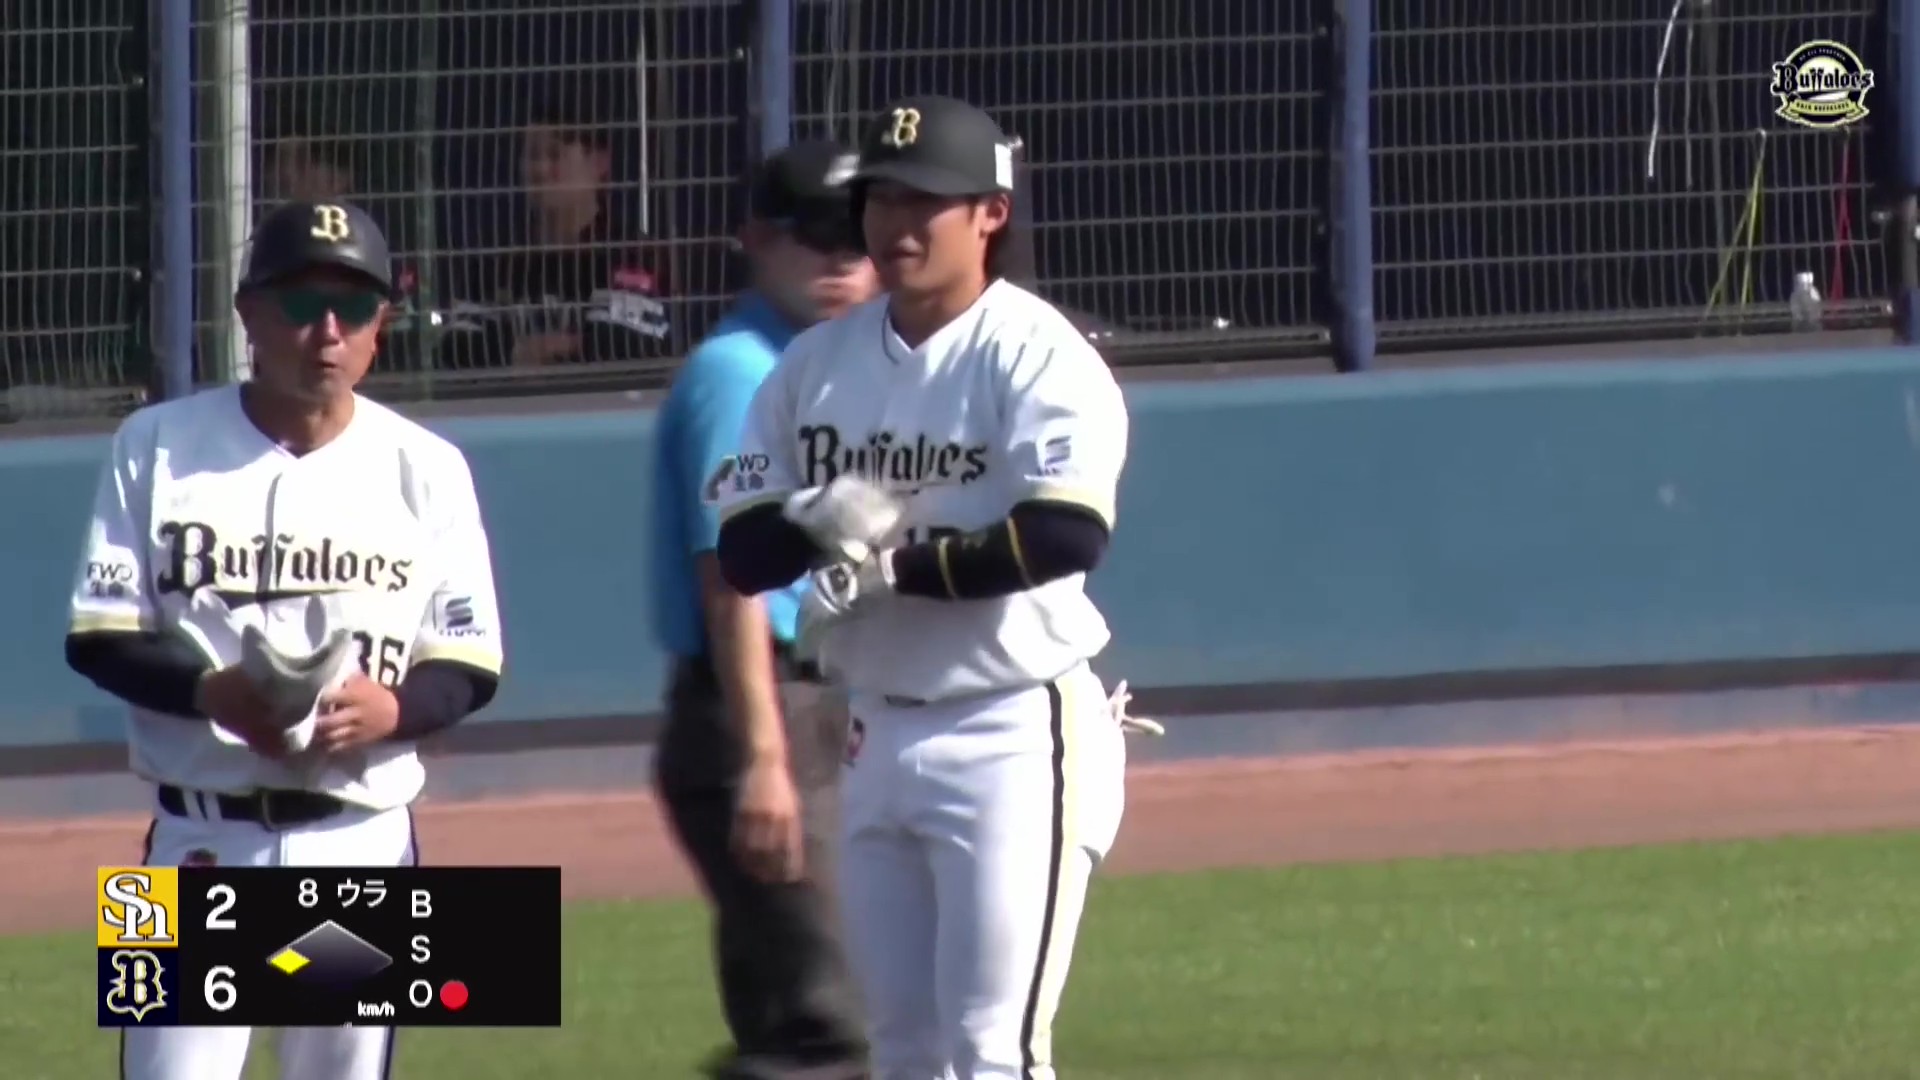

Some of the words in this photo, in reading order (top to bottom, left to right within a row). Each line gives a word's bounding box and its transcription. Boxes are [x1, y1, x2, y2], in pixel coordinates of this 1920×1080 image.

[881, 108, 921, 148] B
[311, 204, 349, 241] B
[157, 521, 412, 598] Buffaloes
